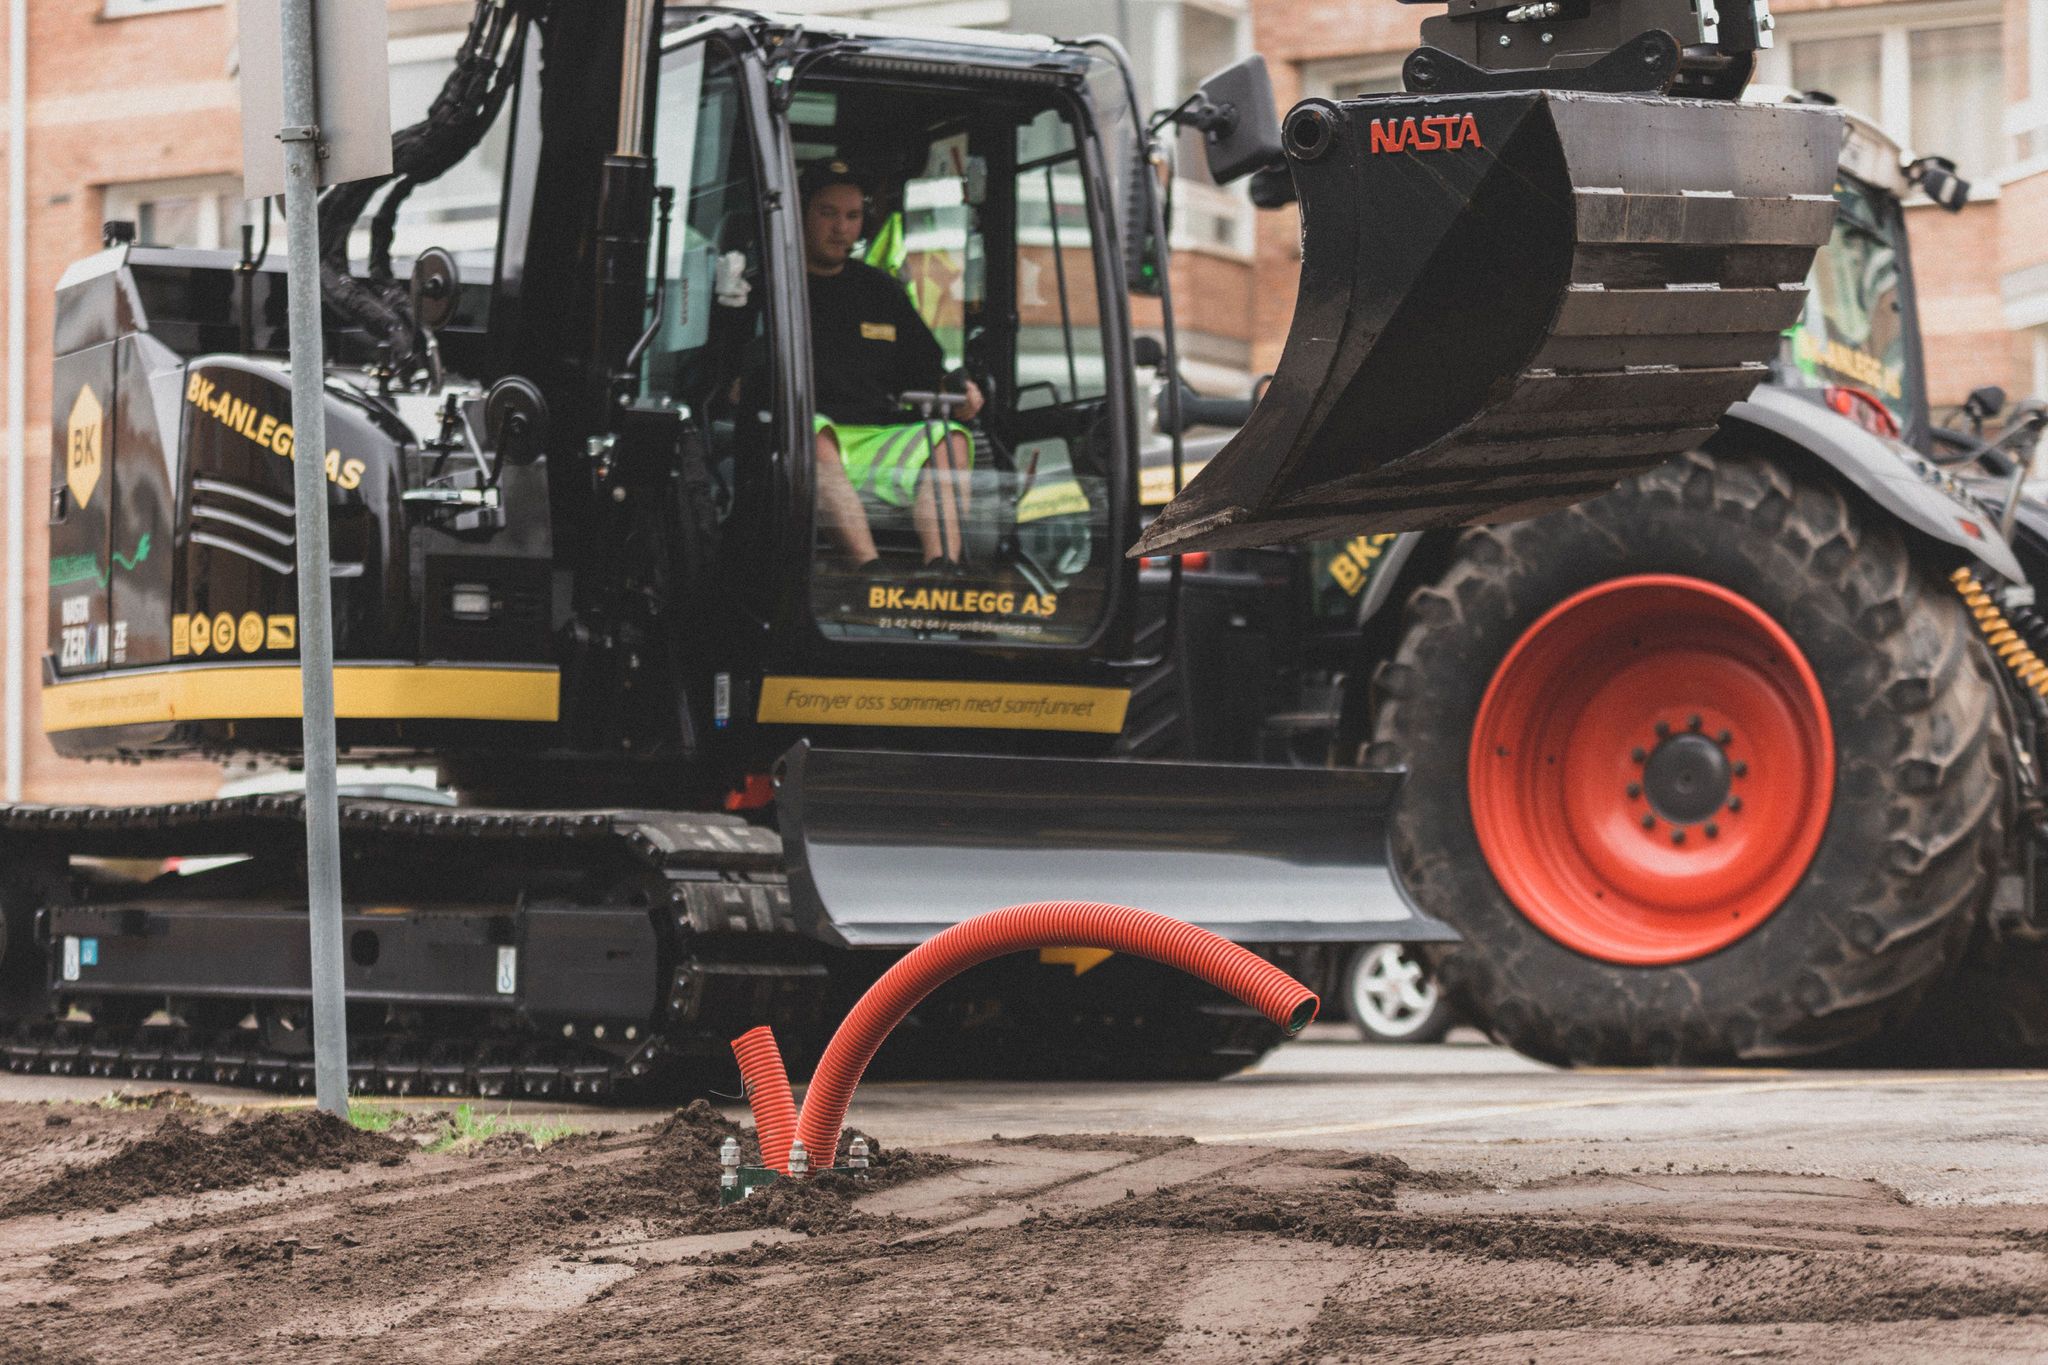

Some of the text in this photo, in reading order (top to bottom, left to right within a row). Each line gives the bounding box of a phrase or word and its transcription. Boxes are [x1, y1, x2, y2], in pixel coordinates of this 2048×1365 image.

[1371, 112, 1482, 154] NASTA
[74, 424, 96, 468] BK
[186, 372, 367, 491] BK-ANLEG AS
[869, 587, 1057, 616] BK-ANLEGG AS
[786, 690, 1095, 717] Fornyer oss sammen med samfunnet
